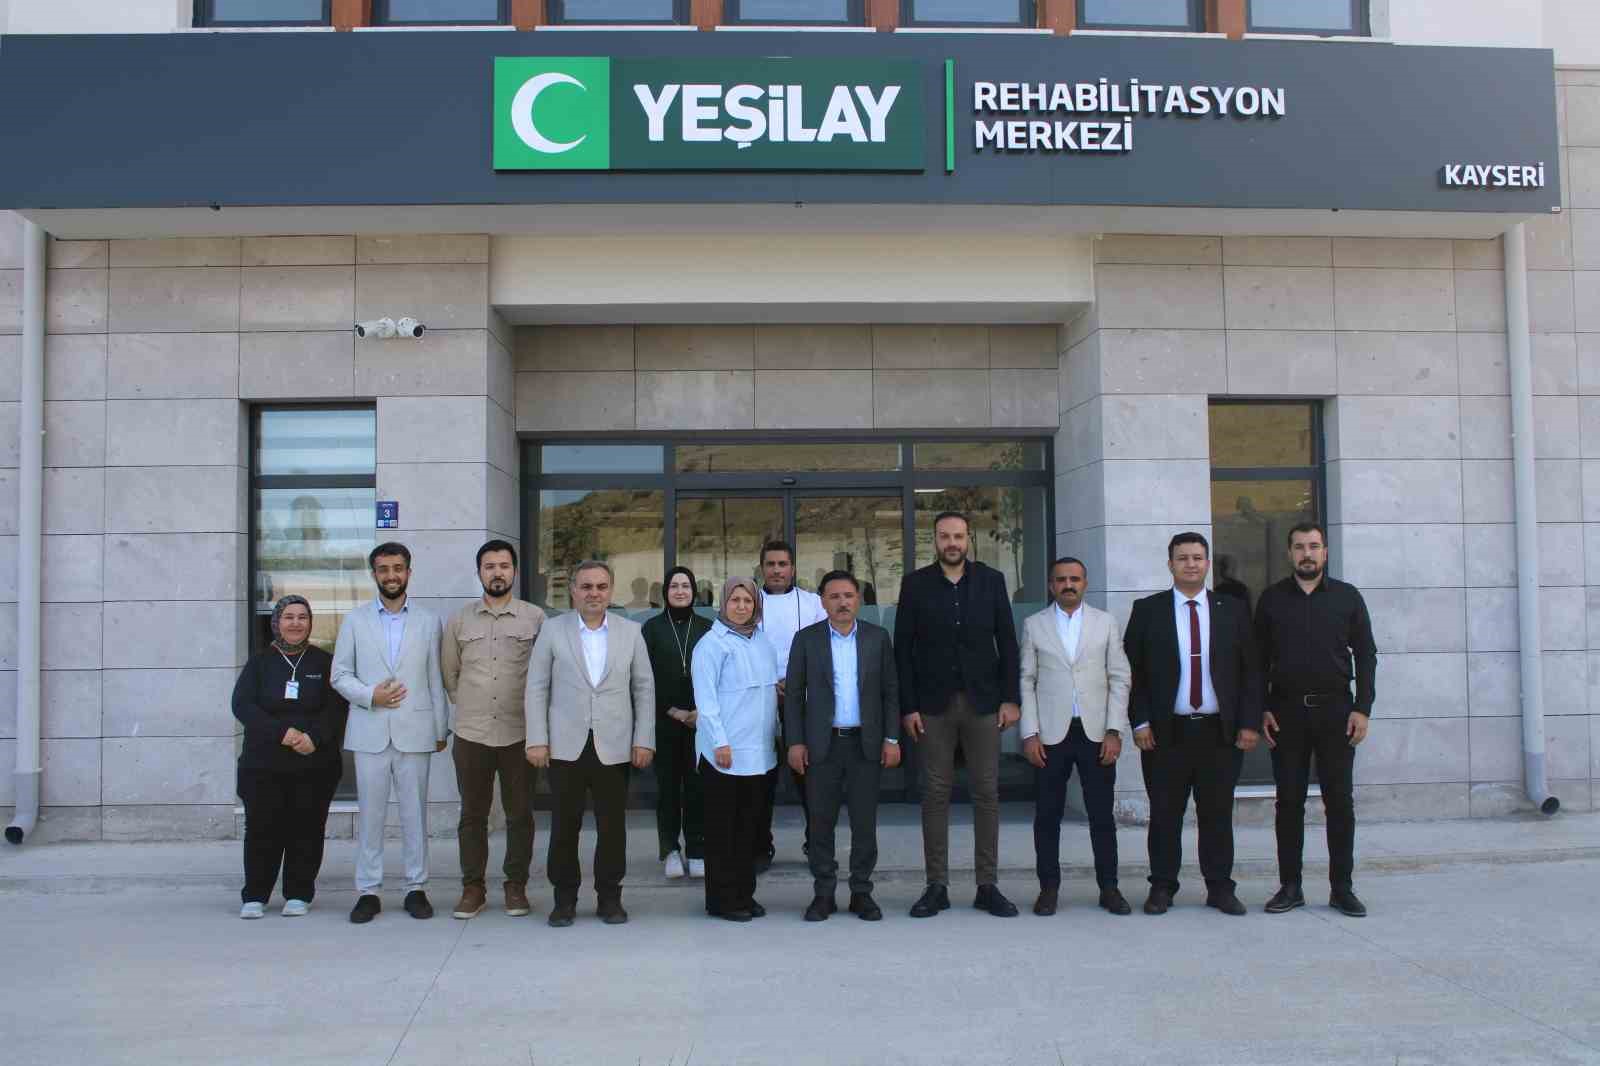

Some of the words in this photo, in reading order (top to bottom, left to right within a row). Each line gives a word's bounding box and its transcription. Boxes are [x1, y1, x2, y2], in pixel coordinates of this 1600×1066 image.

[973, 77, 1286, 116] REHABİLİTASYON
[633, 84, 901, 149] YEŞİLAY
[974, 116, 1133, 151] MERKEZİ
[1445, 161, 1545, 187] KAYSERİ
[383, 508, 392, 519] 3
